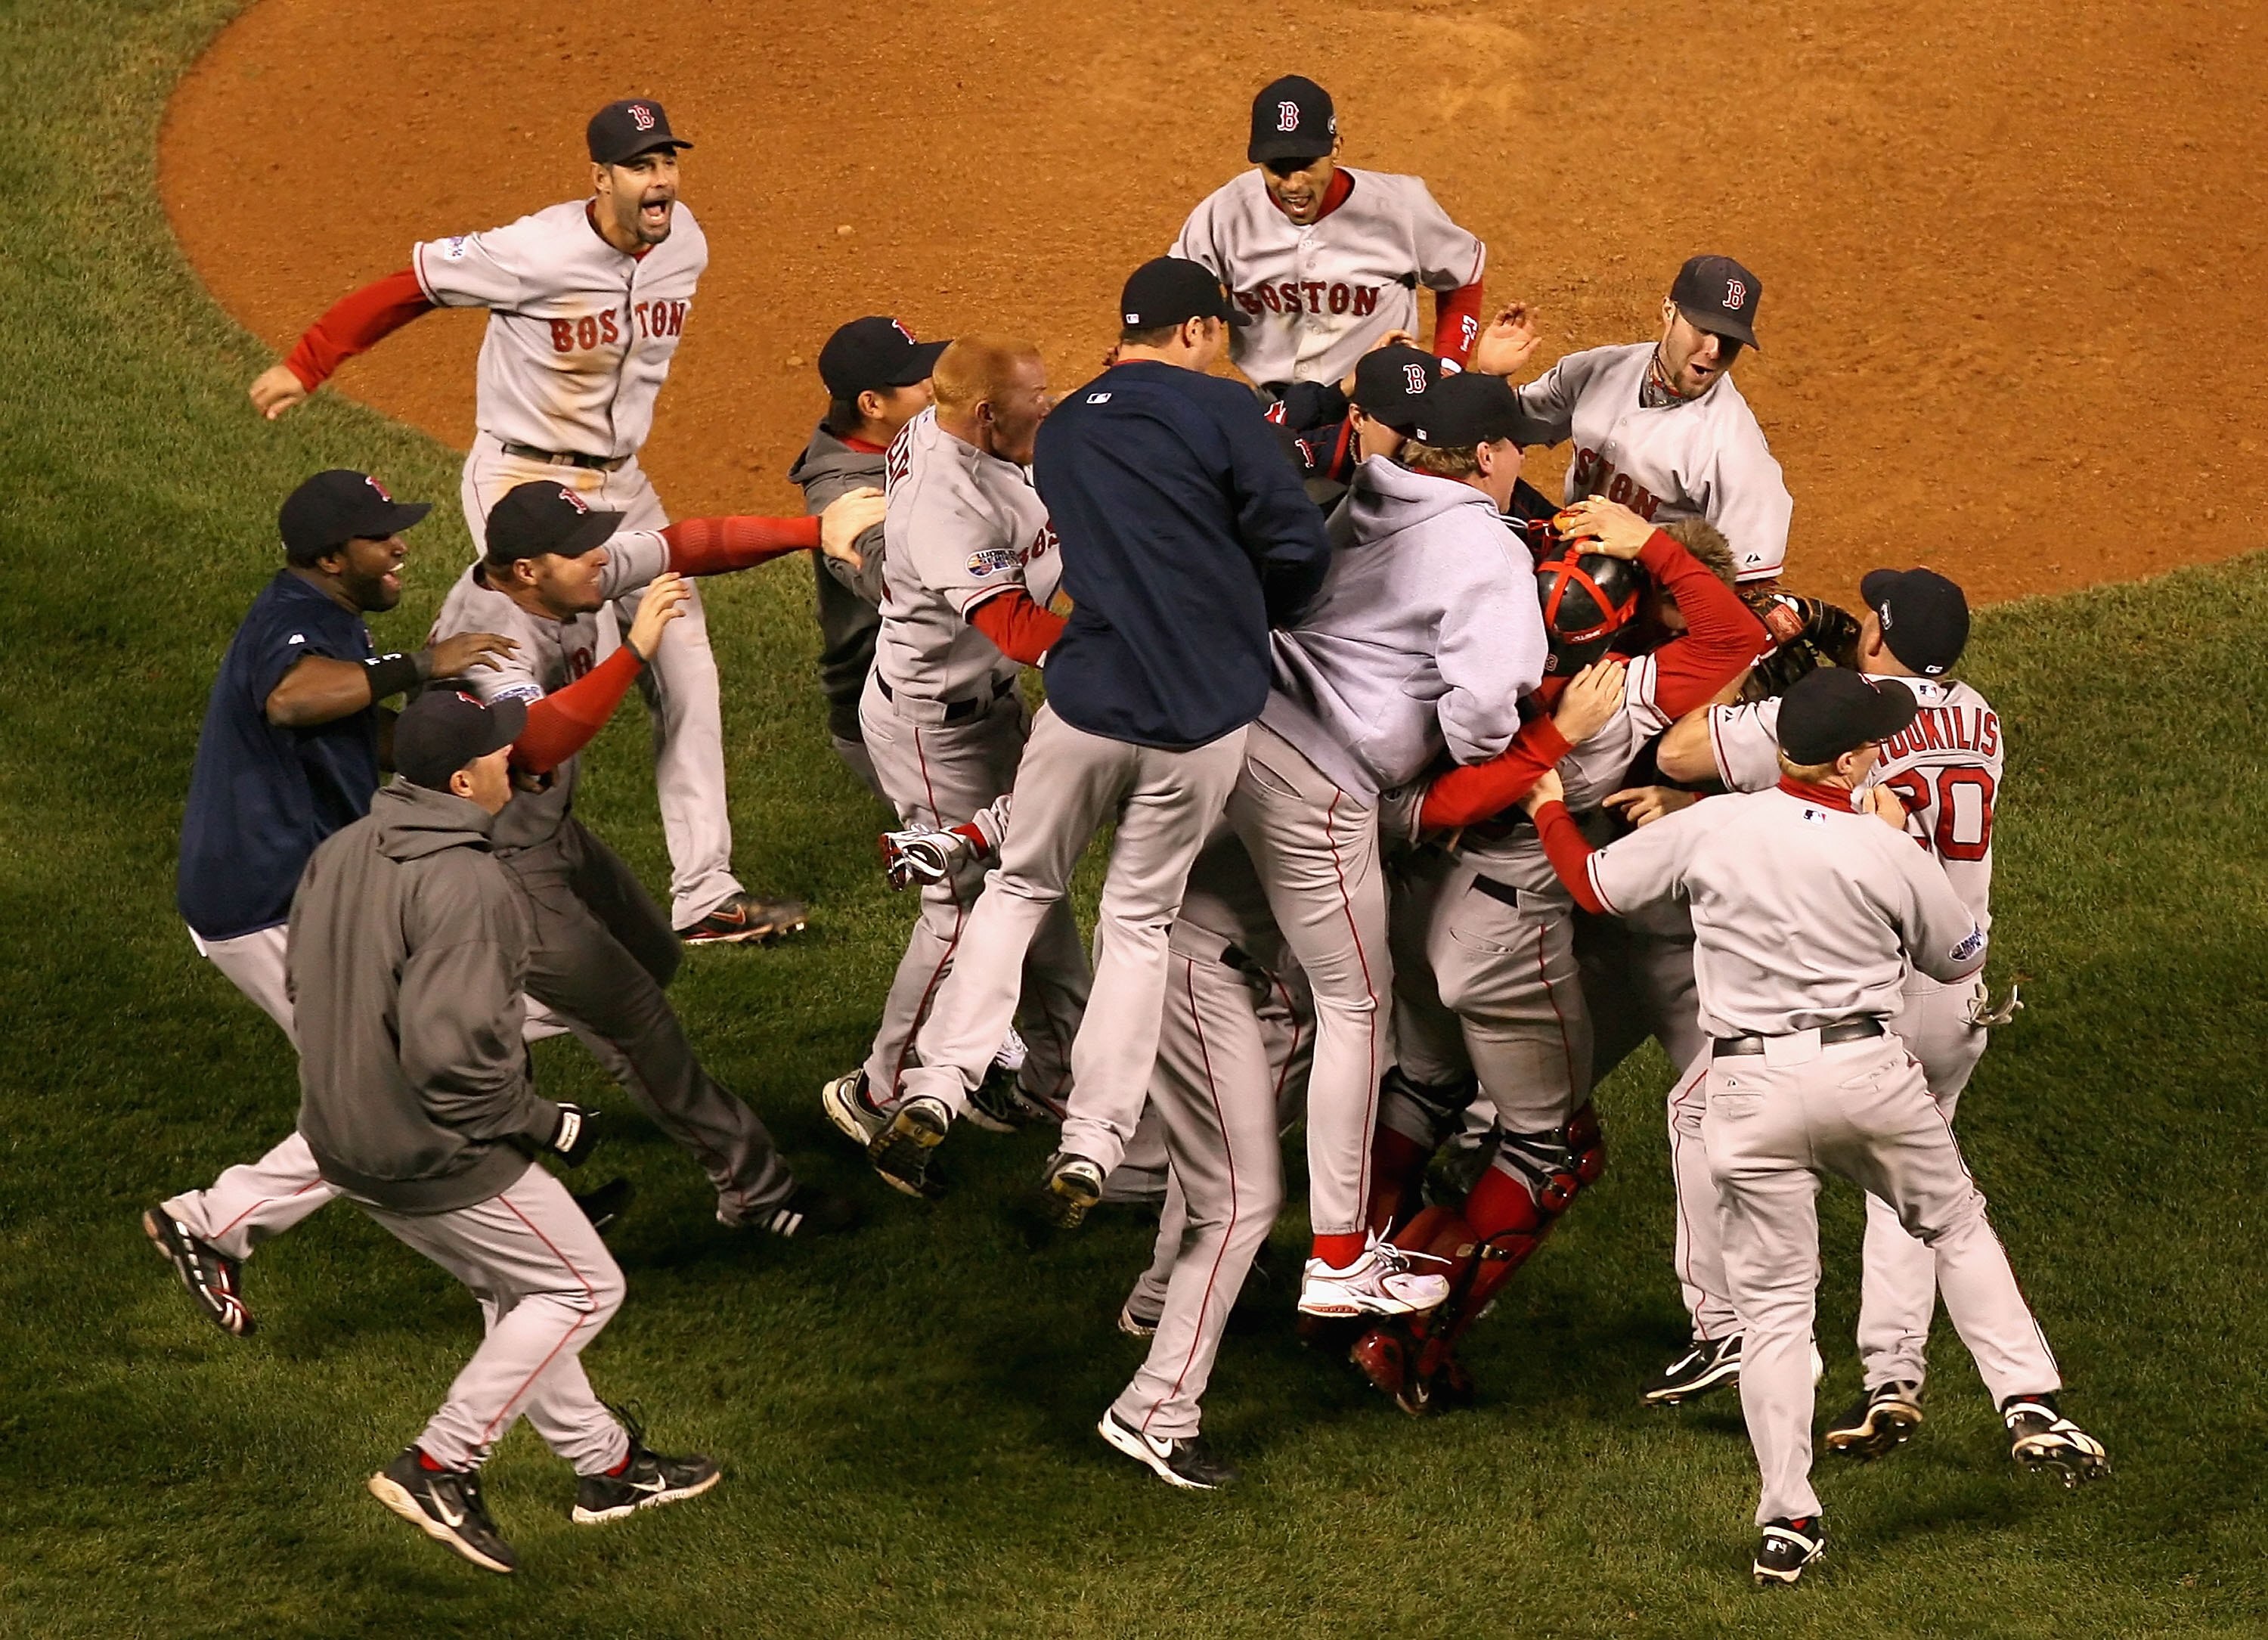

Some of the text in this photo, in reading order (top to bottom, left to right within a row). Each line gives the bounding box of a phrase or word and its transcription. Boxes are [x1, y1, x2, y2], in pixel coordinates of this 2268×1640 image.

[627, 104, 655, 131] B
[1277, 101, 1300, 132] B
[1233, 281, 1380, 316] BOSTON
[1722, 278, 1746, 310] B
[550, 299, 686, 352] BOSTON
[1402, 363, 1427, 394] B
[1573, 447, 1662, 522] STON
